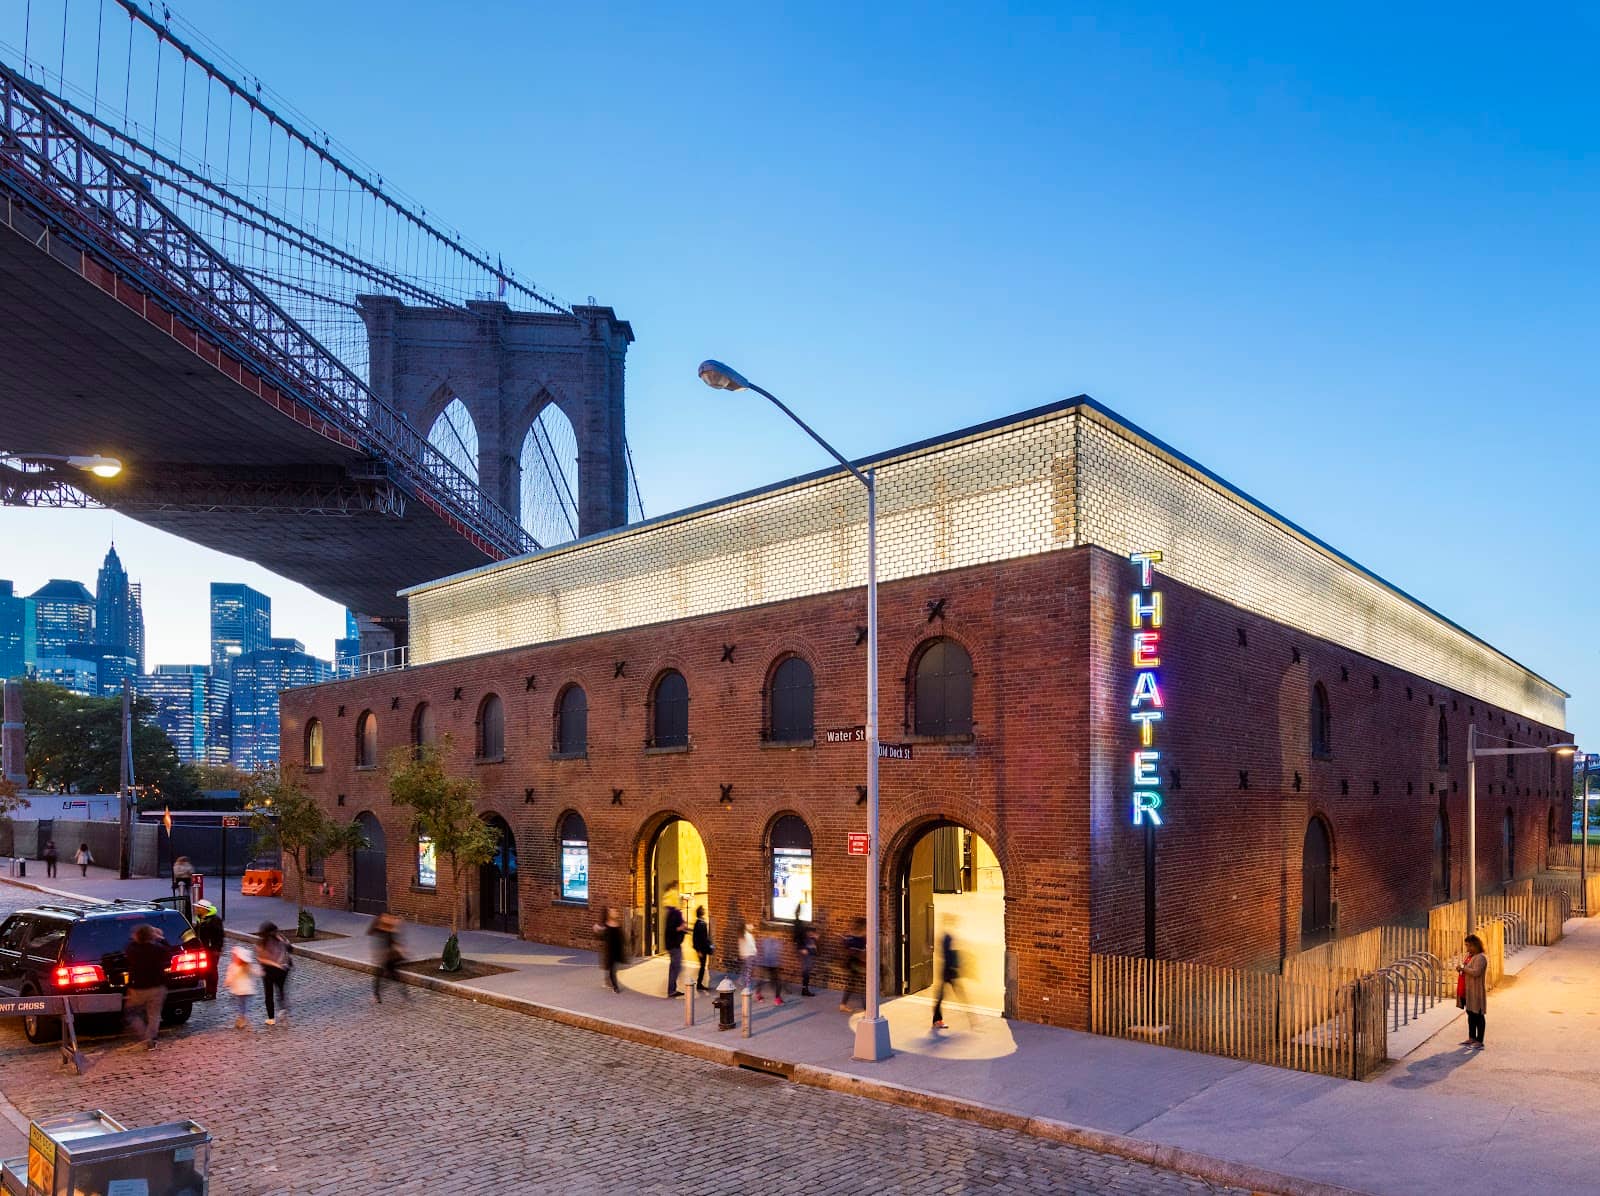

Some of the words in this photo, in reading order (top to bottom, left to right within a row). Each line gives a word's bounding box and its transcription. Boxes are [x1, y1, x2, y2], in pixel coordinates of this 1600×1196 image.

[1130, 551, 1163, 825] THEATER
[827, 730, 852, 742] Water
[855, 729, 865, 741] St
[879, 745, 888, 757] Old
[889, 747, 903, 759] Dock
[904, 748, 910, 759] St
[18, 1002, 45, 1011] CROSS
